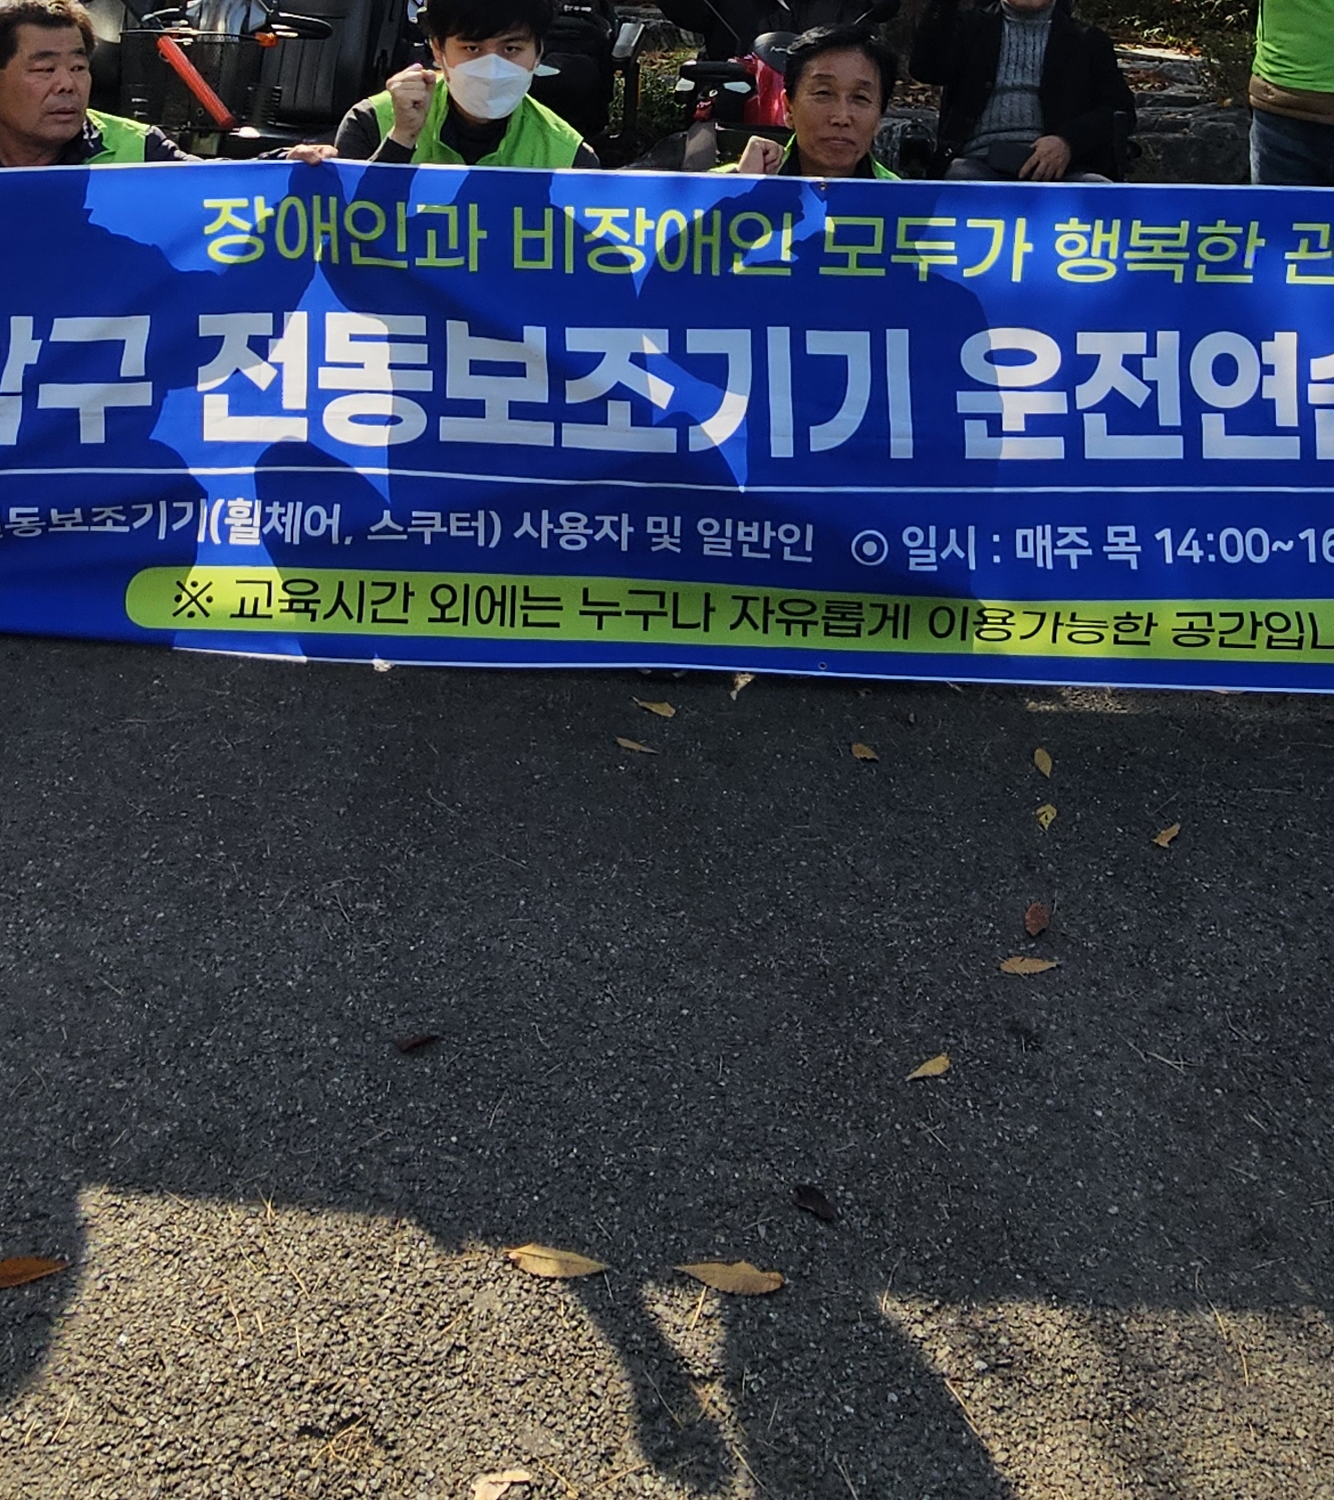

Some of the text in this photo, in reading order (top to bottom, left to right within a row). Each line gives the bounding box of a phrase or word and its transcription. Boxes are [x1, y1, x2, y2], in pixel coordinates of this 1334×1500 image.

[203, 195, 487, 271] 장애인과
[513, 205, 793, 277] 비장애인
[818, 216, 1033, 283] 모두가
[1054, 217, 1265, 284] 행복한
[196, 310, 914, 460] 전동보조기기
[367, 509, 502, 548] 스쿠터)
[513, 510, 634, 552] 사용자
[645, 514, 683, 554] 및
[696, 516, 815, 563] 일반인
[901, 525, 977, 572] 일시
[1016, 525, 1093, 571] 매주
[1103, 525, 1142, 571] 목
[229, 578, 415, 624] 교육시간
[428, 582, 562, 629] 외에는
[578, 587, 715, 633] 누구나
[730, 593, 911, 641] 자유롭게
[927, 604, 1158, 649] 이용가능한
